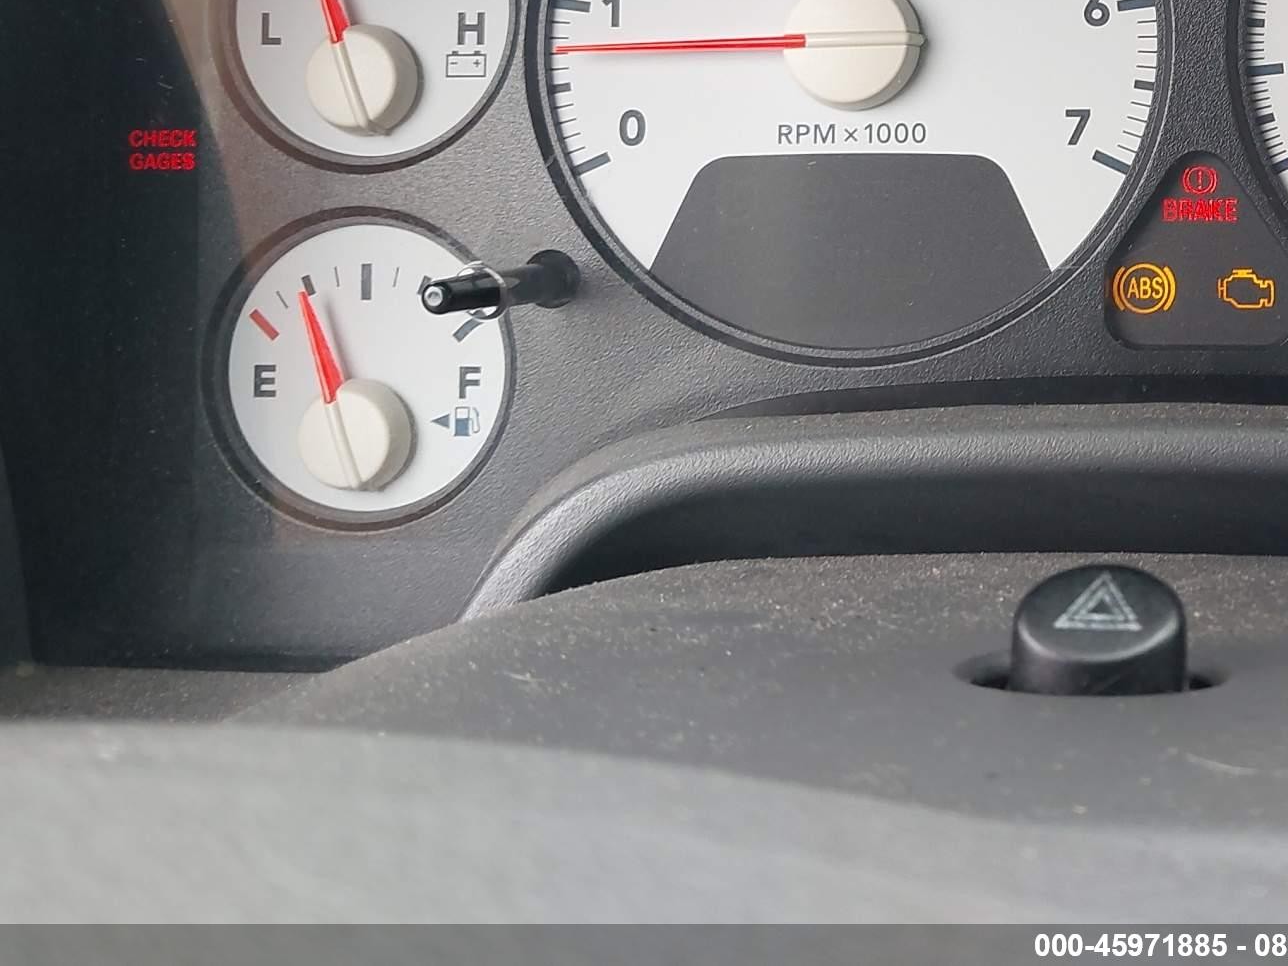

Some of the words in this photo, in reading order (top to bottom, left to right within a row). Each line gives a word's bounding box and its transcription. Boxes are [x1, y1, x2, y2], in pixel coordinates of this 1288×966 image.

[261, 13, 281, 45] L
[457, 12, 485, 45] H
[129, 130, 196, 147] CHECK
[619, 110, 645, 146] 0
[778, 124, 835, 144] RPM
[1066, 109, 1090, 145] 7
[130, 152, 195, 170] GAGES
[1164, 198, 1235, 221] BRAKE
[1126, 276, 1164, 300] ABS
[254, 365, 276, 397] E
[459, 366, 481, 399] F
